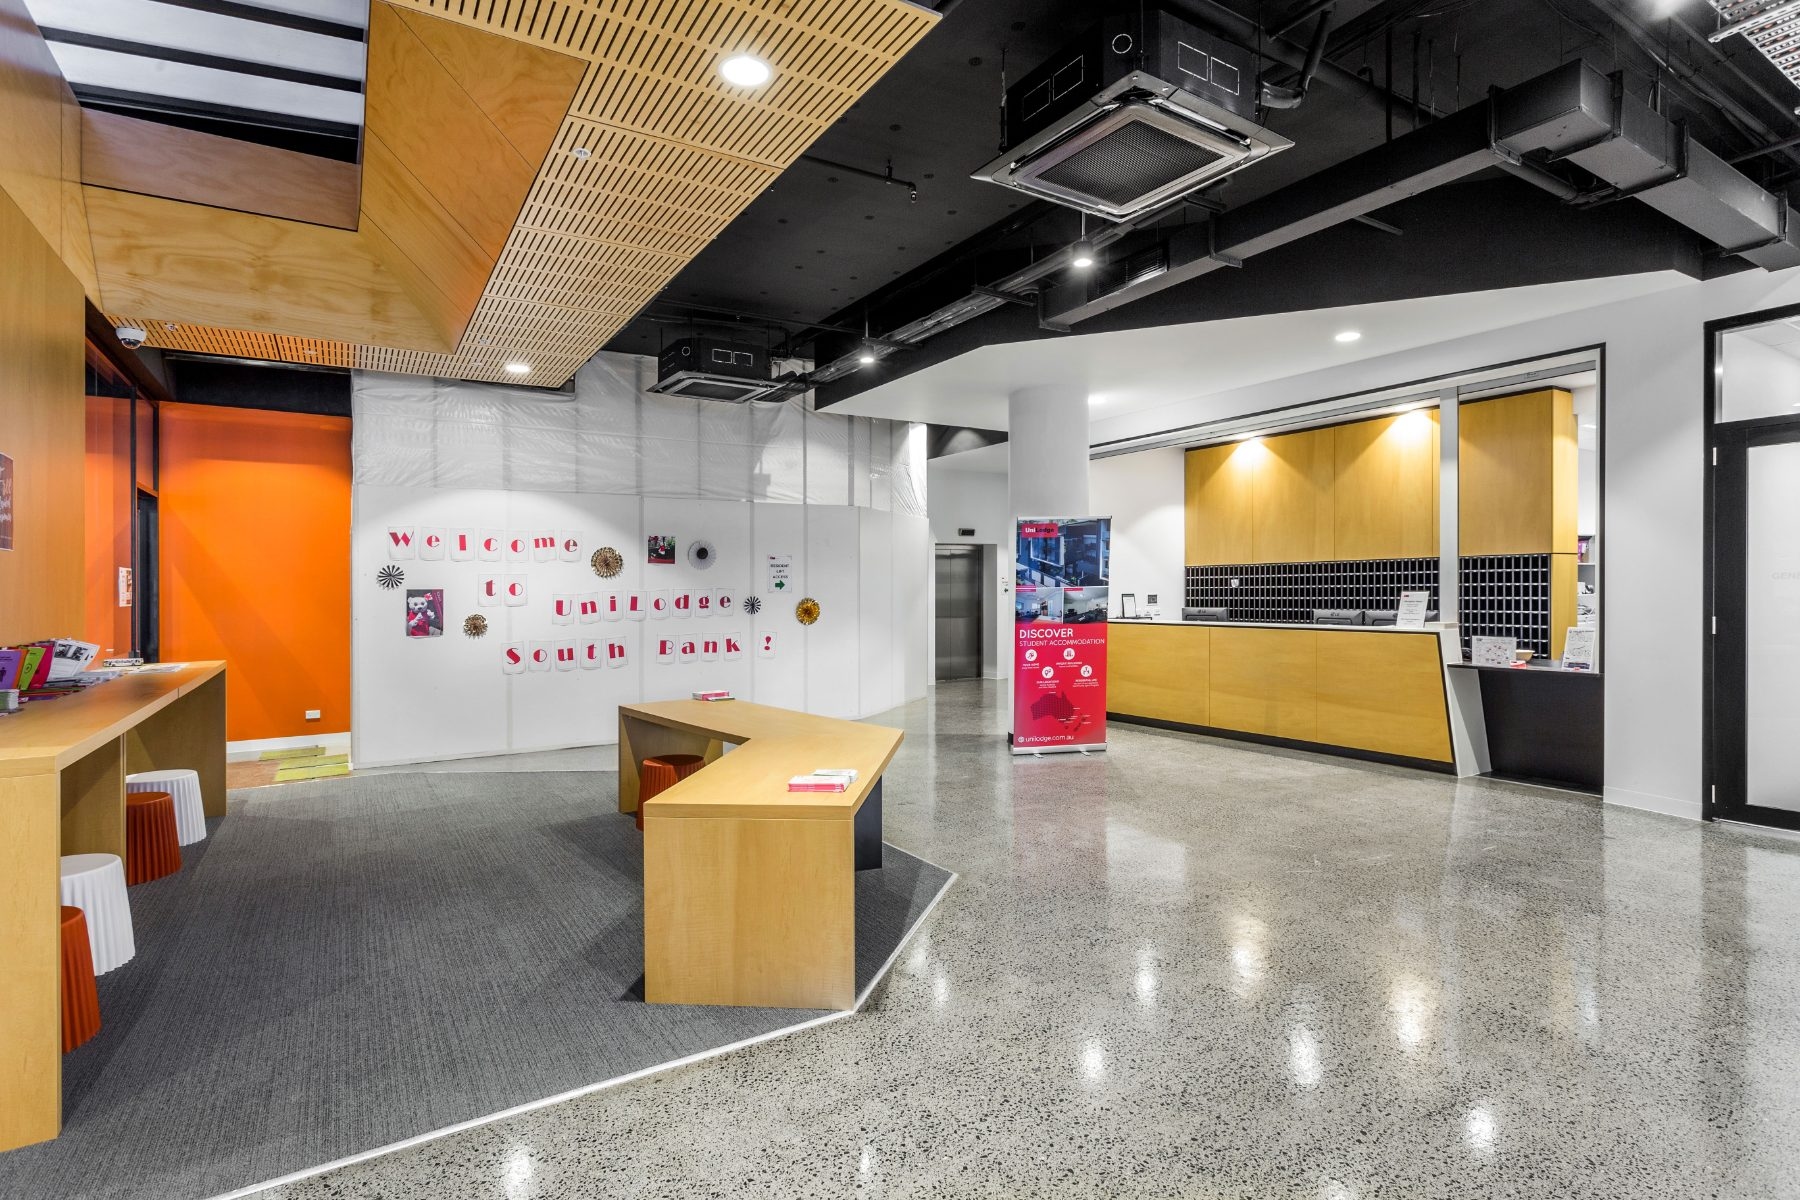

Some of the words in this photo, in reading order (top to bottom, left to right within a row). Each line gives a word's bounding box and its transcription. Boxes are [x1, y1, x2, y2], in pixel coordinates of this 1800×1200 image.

[389, 530, 578, 552] Welcome
[485, 579, 523, 597] to
[555, 594, 731, 616] UniLodge
[1019, 628, 1074, 639] DISCOVER
[1049, 638, 1105, 646] ACCOMMODATION
[506, 643, 625, 665] South
[1025, 735, 1075, 743] unilodge.com.au
